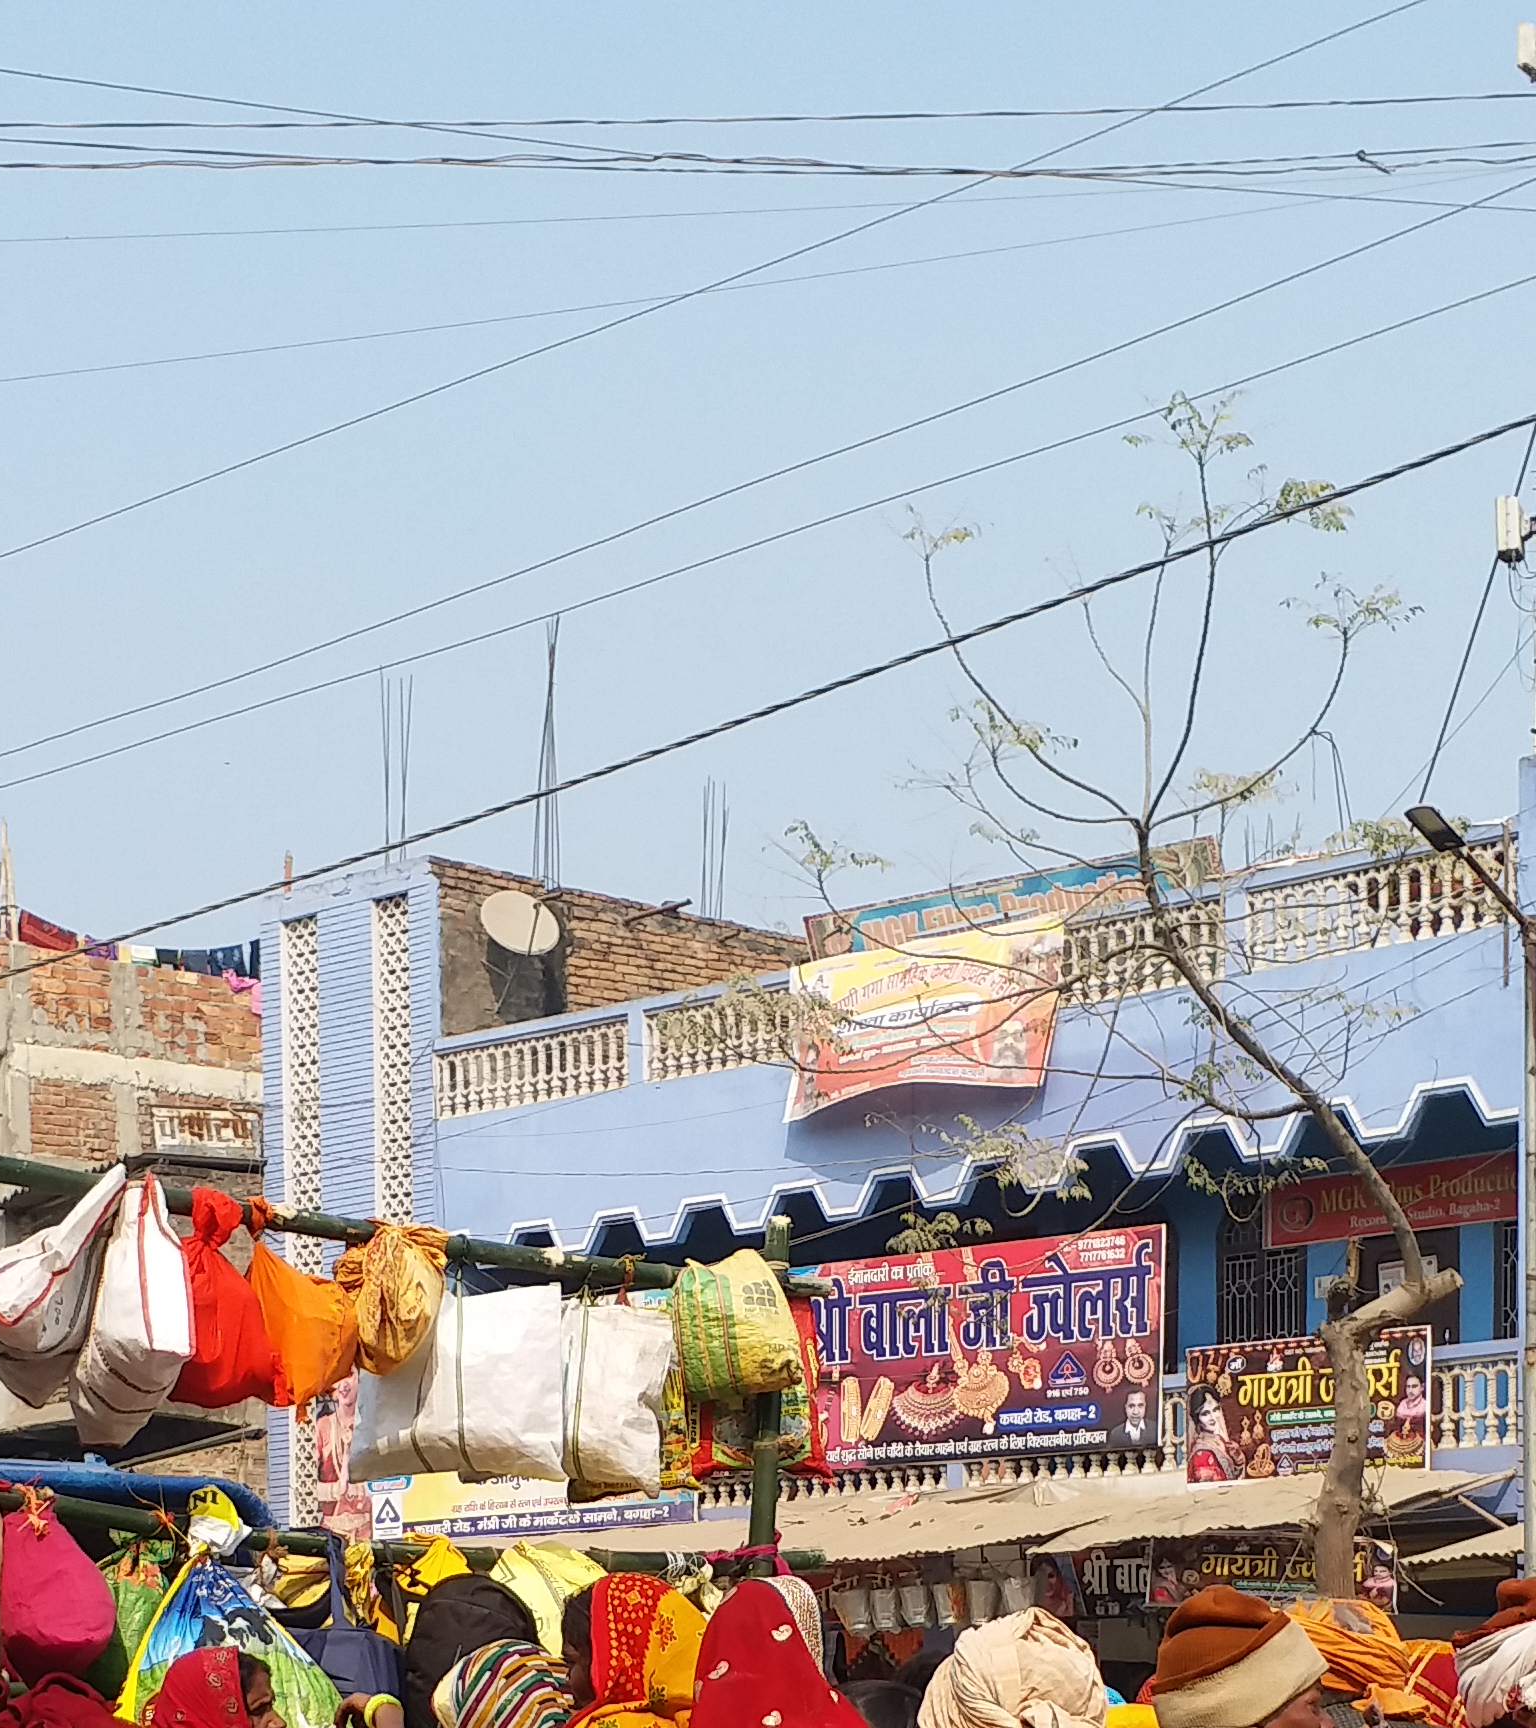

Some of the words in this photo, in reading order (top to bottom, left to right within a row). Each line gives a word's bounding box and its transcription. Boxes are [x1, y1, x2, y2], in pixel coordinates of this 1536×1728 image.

[1237, 1357, 1315, 1408] गायत्री
[1082, 1548, 1111, 1596] श्री
[1201, 1546, 1279, 1579] गायत्री
